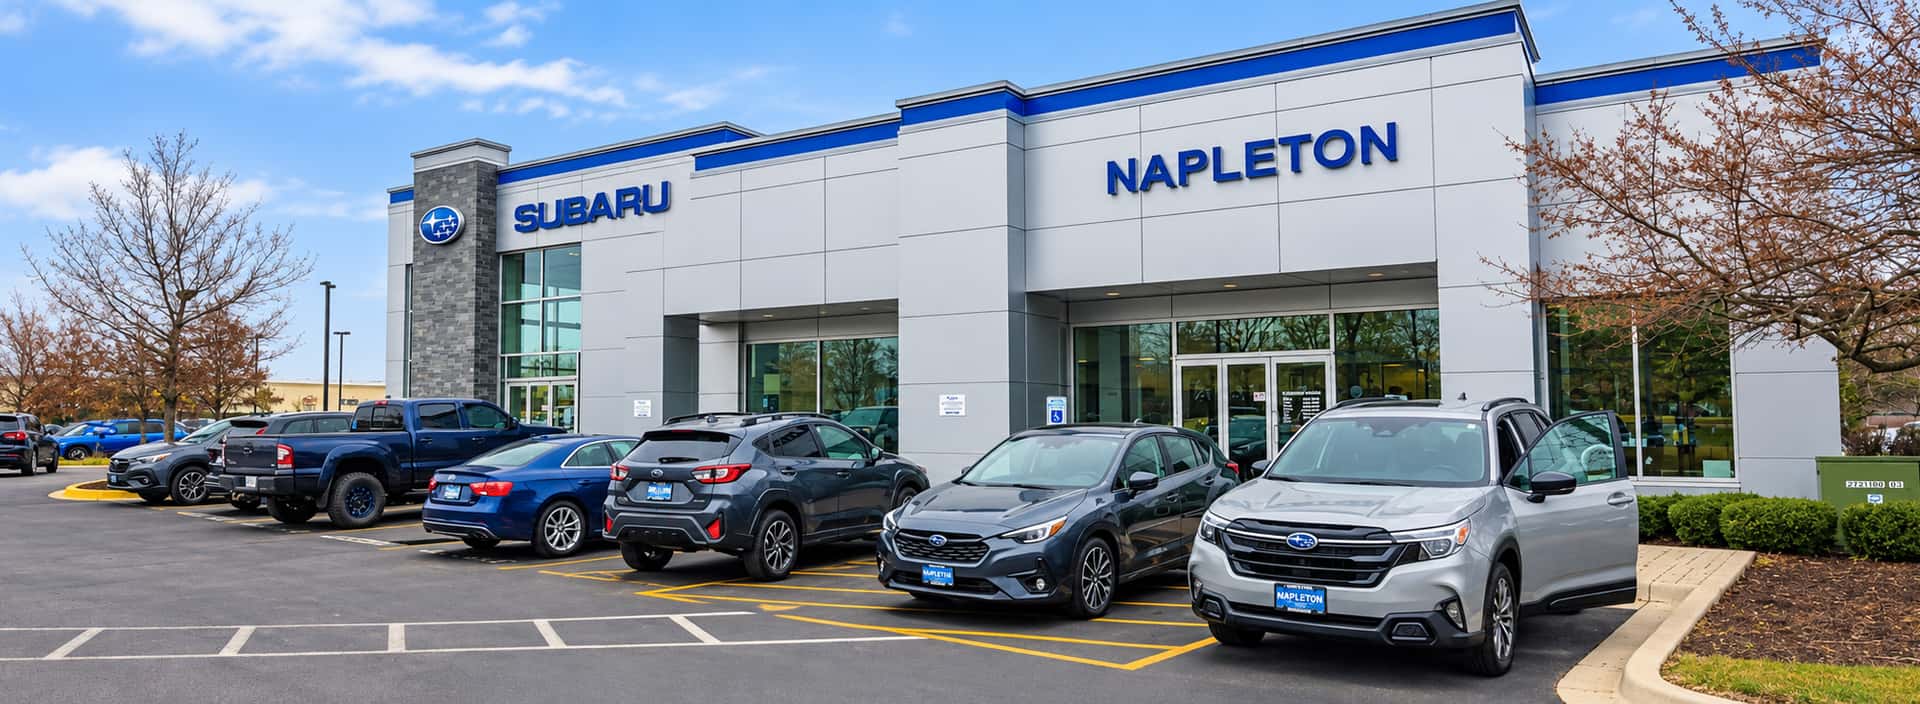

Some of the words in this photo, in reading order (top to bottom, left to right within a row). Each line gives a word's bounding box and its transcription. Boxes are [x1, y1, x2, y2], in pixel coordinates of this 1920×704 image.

[1107, 122, 1398, 195] NAPLETON
[514, 181, 671, 233] SUBARU
[1277, 592, 1323, 603] NAPLETON
